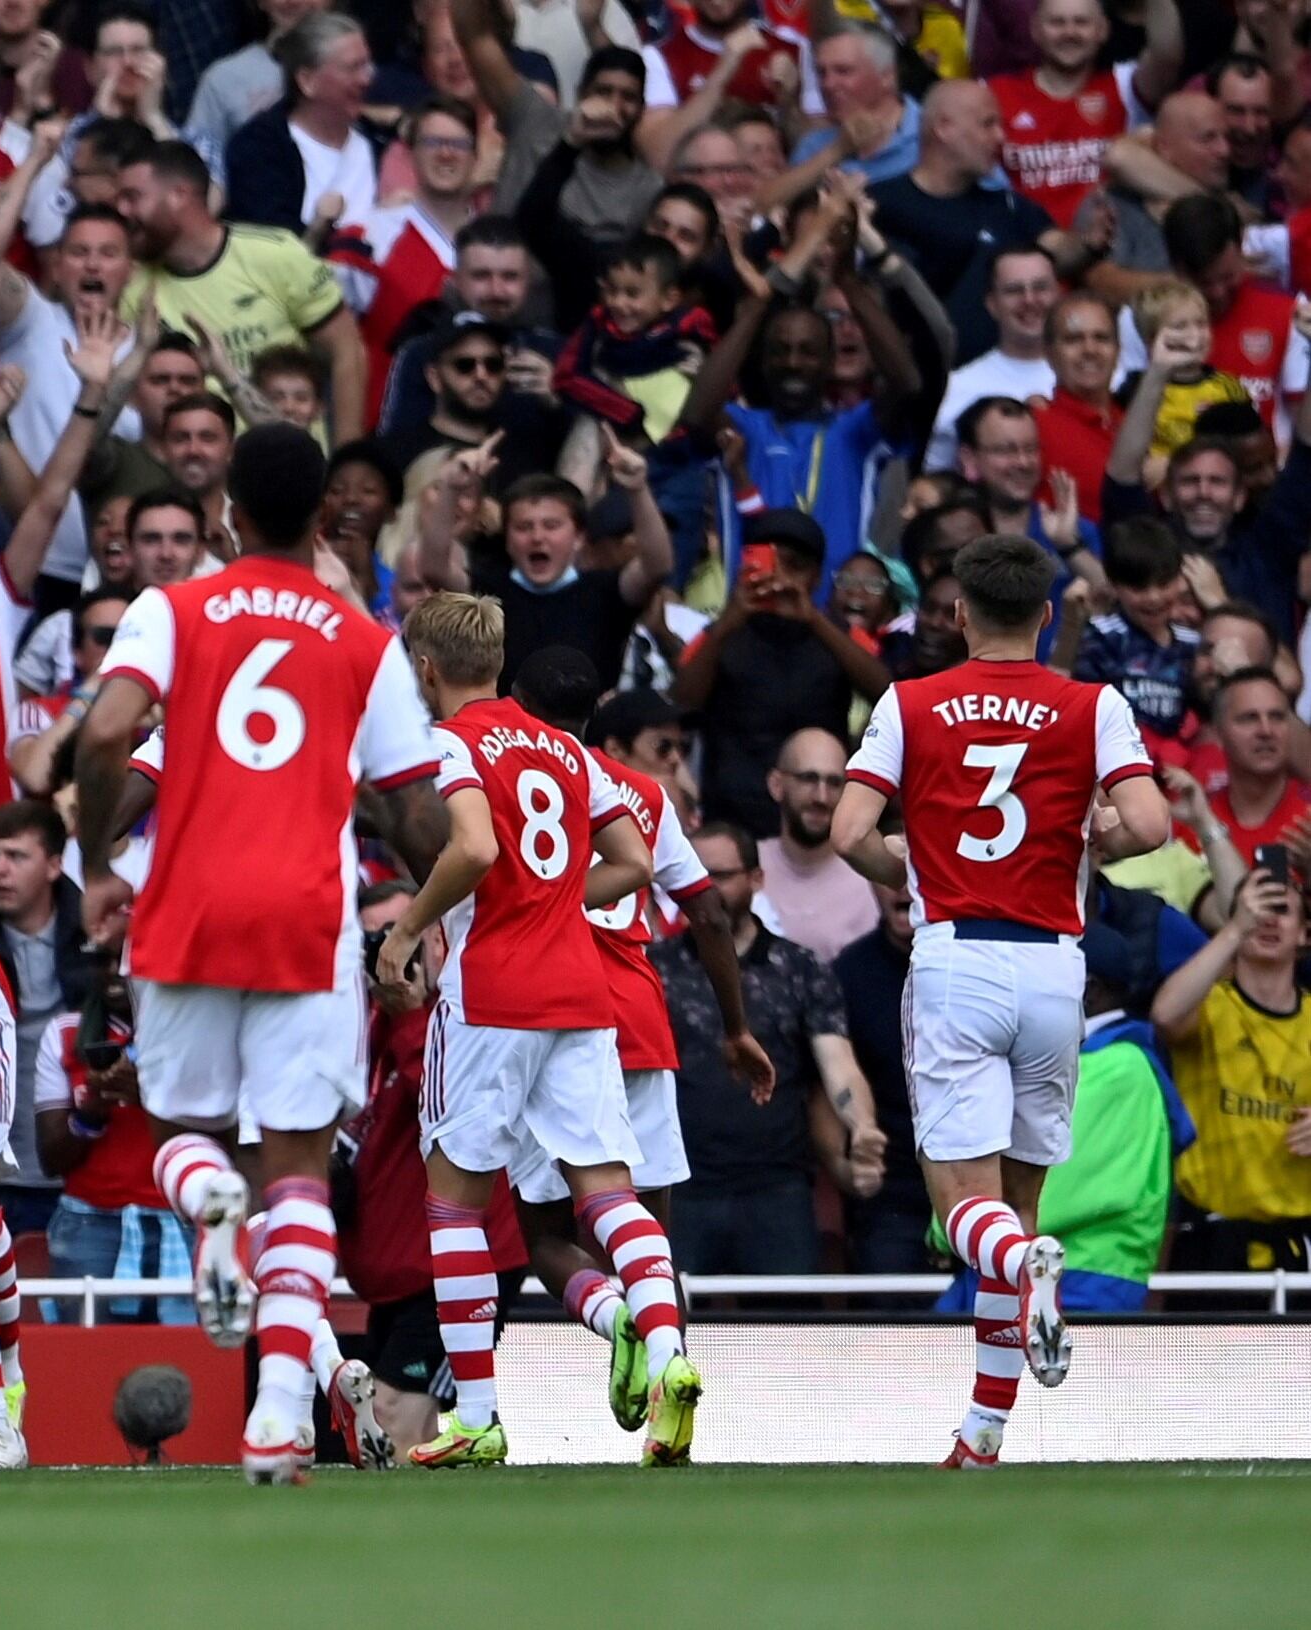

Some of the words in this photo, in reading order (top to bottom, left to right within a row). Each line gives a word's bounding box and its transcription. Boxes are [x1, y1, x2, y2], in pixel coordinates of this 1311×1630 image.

[204, 586, 344, 642] GABRIEL
[216, 638, 306, 771] 6
[517, 769, 570, 880] 8
[956, 743, 1029, 862] 3
